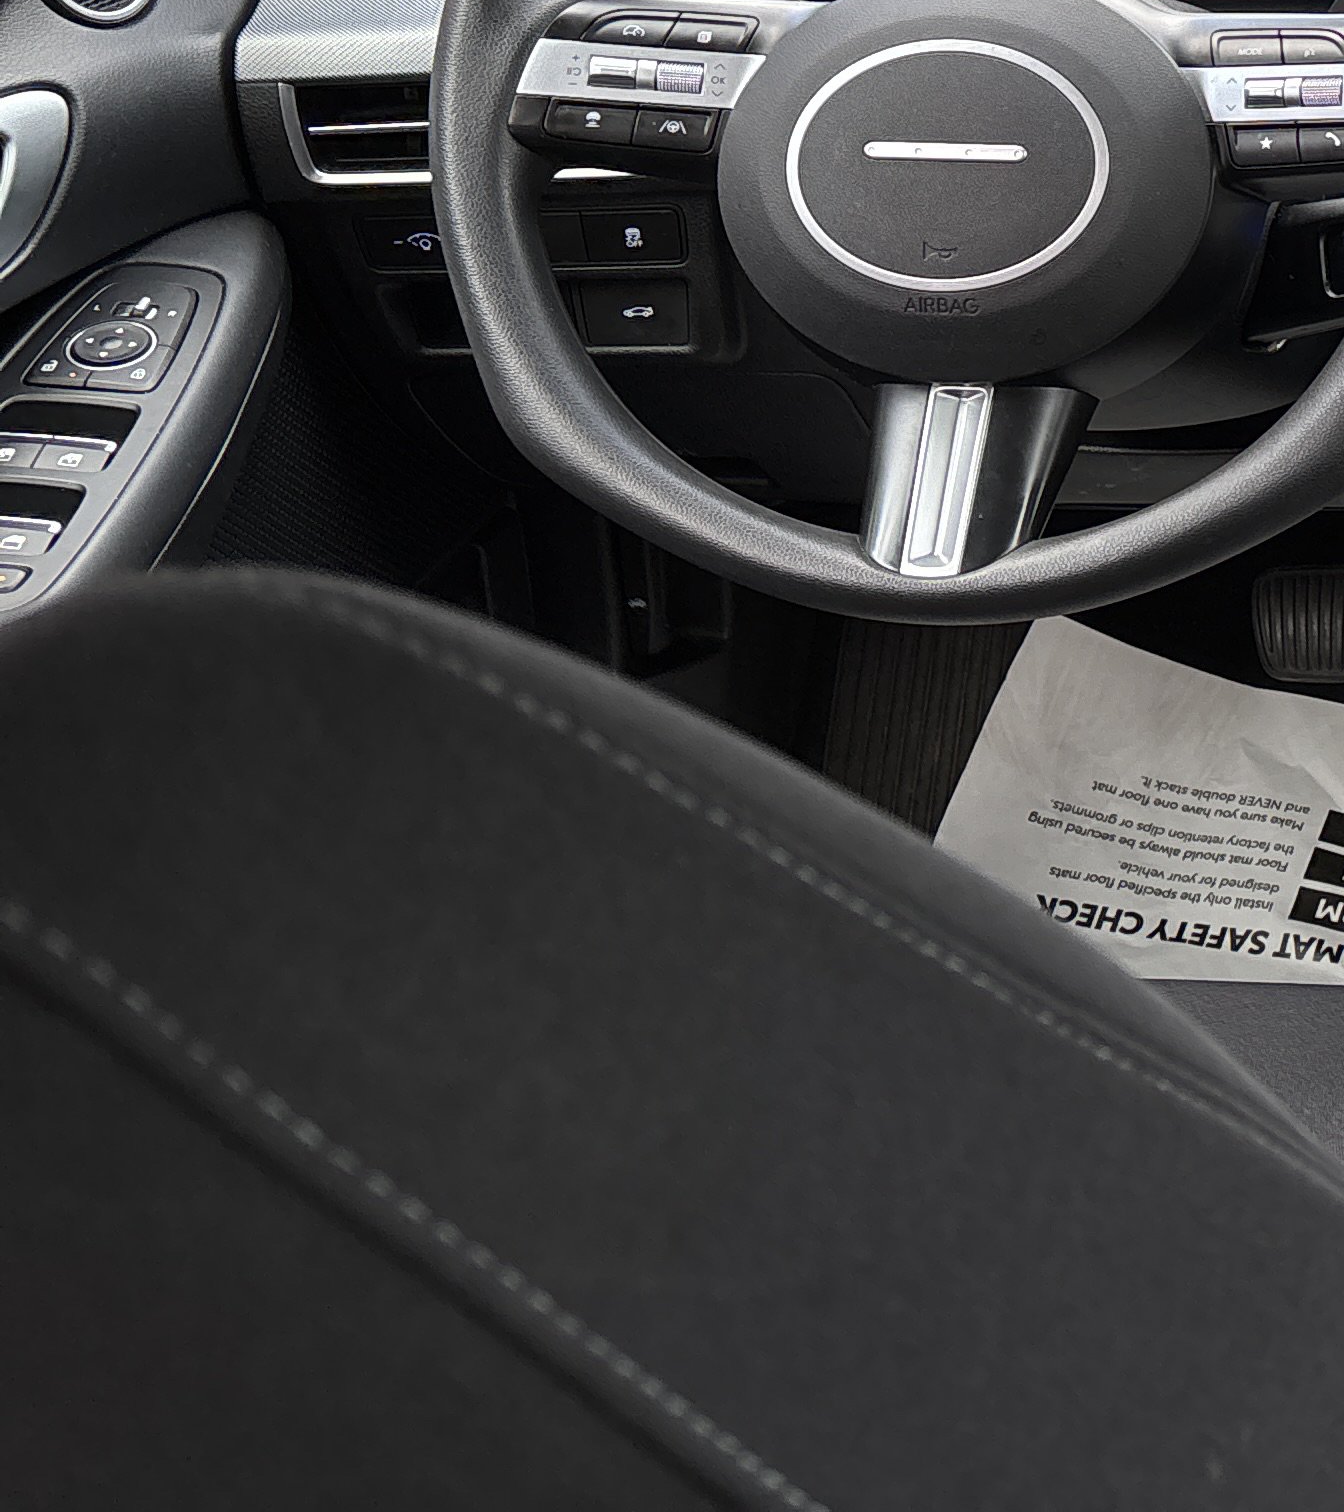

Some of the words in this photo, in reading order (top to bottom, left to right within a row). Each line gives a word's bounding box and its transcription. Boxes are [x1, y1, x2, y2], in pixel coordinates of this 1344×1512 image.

[1238, 48, 1263, 56] MODE
[711, 76, 727, 85] OK
[903, 296, 980, 315] AIRBAG
[1092, 780, 1118, 794] mat
[1141, 775, 1153, 789] it.
[1155, 779, 1188, 795] stack
[1118, 790, 1150, 806] floor
[1153, 797, 1178, 809] one
[1190, 789, 1236, 804] double
[1238, 795, 1282, 811] NEVER
[1050, 799, 1118, 824] grommets.
[1181, 804, 1211, 818] have
[1214, 808, 1239, 819] you
[1283, 803, 1310, 814] and
[1027, 811, 1063, 829] using
[1118, 820, 1134, 829] or
[1240, 812, 1268, 823] sure
[1270, 816, 1305, 831] Make
[1064, 823, 1117, 842] secured
[1137, 822, 1165, 837] clips
[1167, 828, 1225, 845] retention
[1118, 837, 1137, 849] be
[1139, 840, 1182, 859] always
[1227, 834, 1271, 853] factory
[1273, 843, 1295, 856] the
[1182, 849, 1227, 863] should
[1229, 854, 1254, 866] mat
[1118, 860, 1165, 880] vehicle.
[1256, 858, 1289, 872] Floor
[1049, 866, 1082, 880] mats
[1167, 872, 1198, 884] your
[1083, 873, 1116, 889] floor
[1200, 876, 1217, 888] for
[1218, 877, 1280, 895] designed
[1117, 879, 1177, 899] specified
[1180, 892, 1202, 904] the
[1204, 892, 1232, 905] only
[1233, 897, 1274, 912] Install
[1037, 894, 1144, 934] CHECK
[1146, 918, 1270, 955] SAFETY
[1271, 933, 1344, 963] MAT
